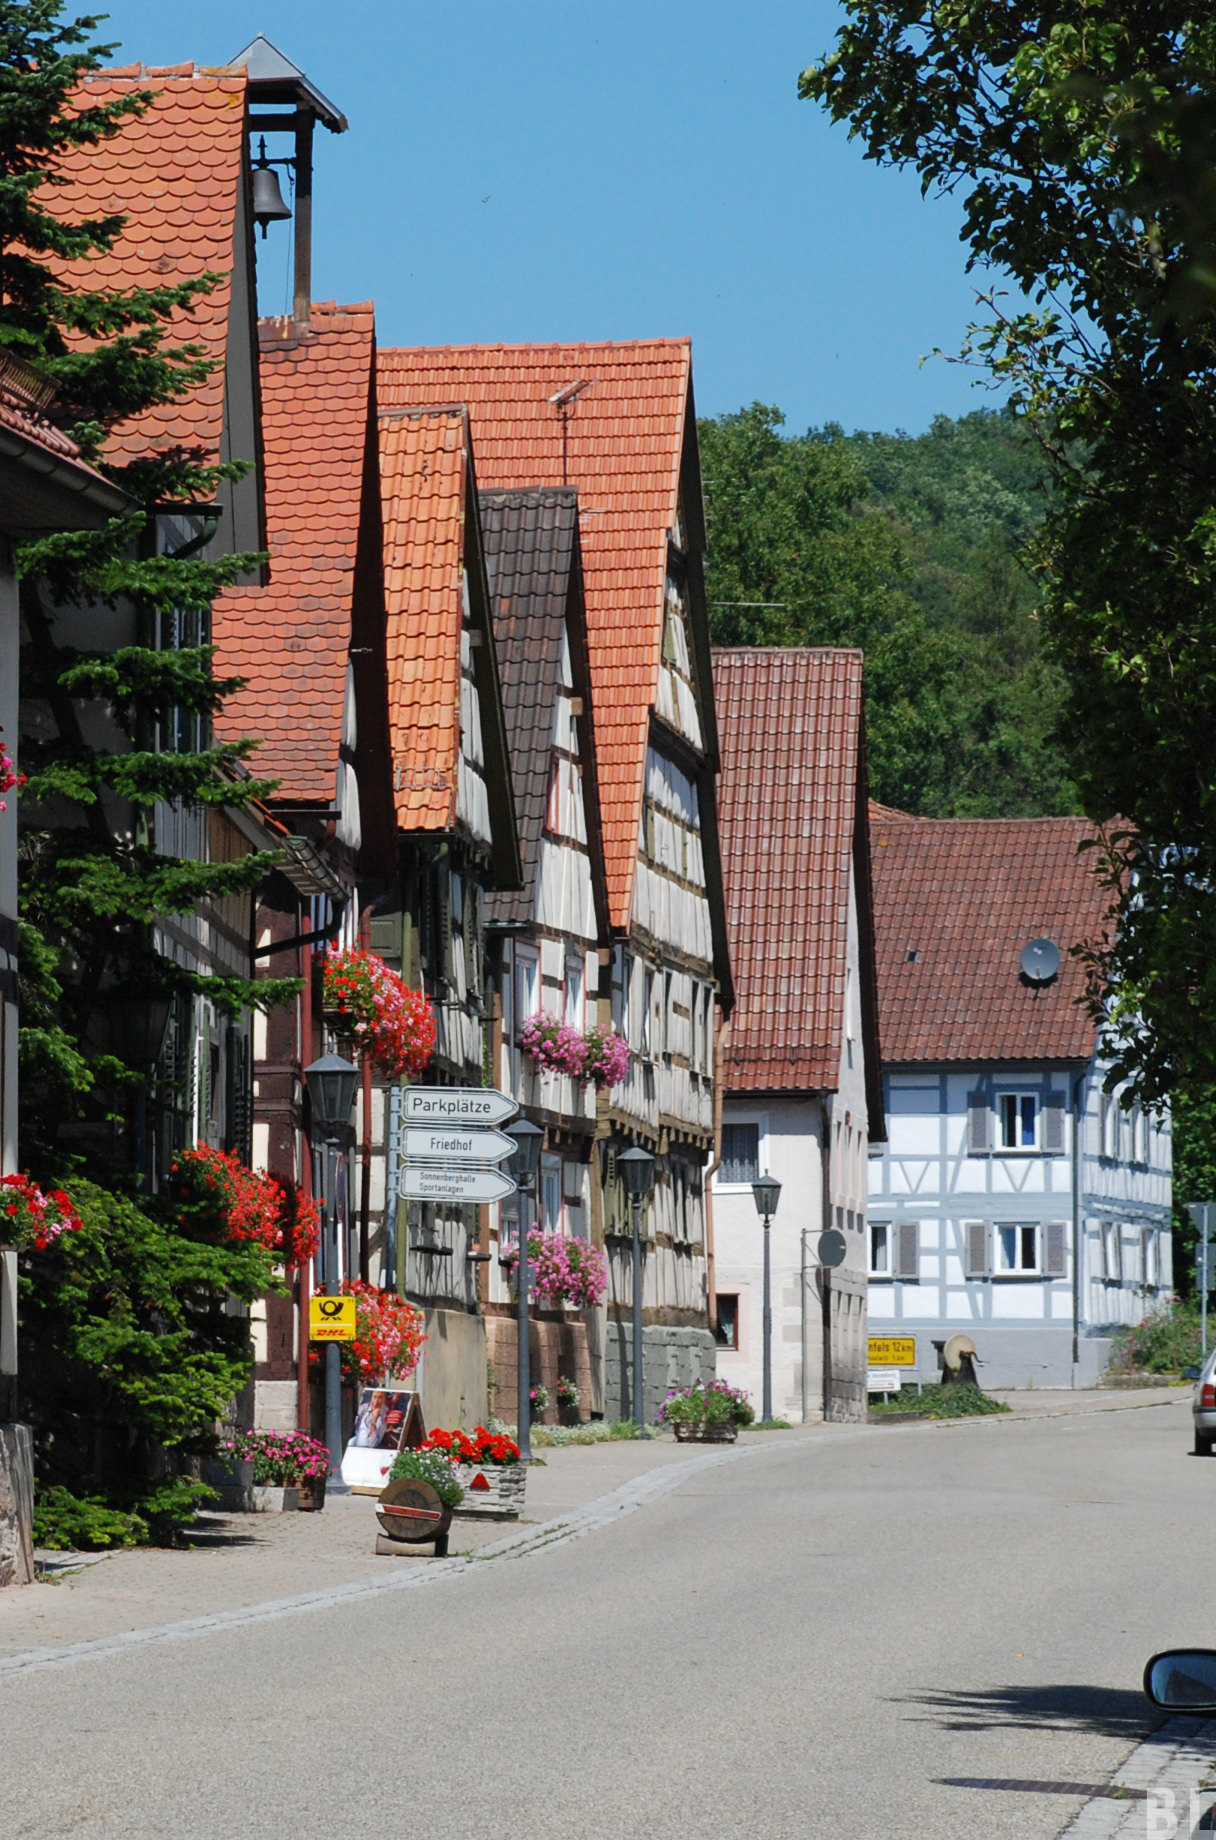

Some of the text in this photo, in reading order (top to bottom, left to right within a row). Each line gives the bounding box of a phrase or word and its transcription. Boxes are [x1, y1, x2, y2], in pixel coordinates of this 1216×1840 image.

[412, 1097, 491, 1115] Parkplätze
[430, 1137, 472, 1151] Friedhof
[420, 1172, 476, 1184] Sonnenberghalle
[419, 1183, 464, 1194] Sportanlagen
